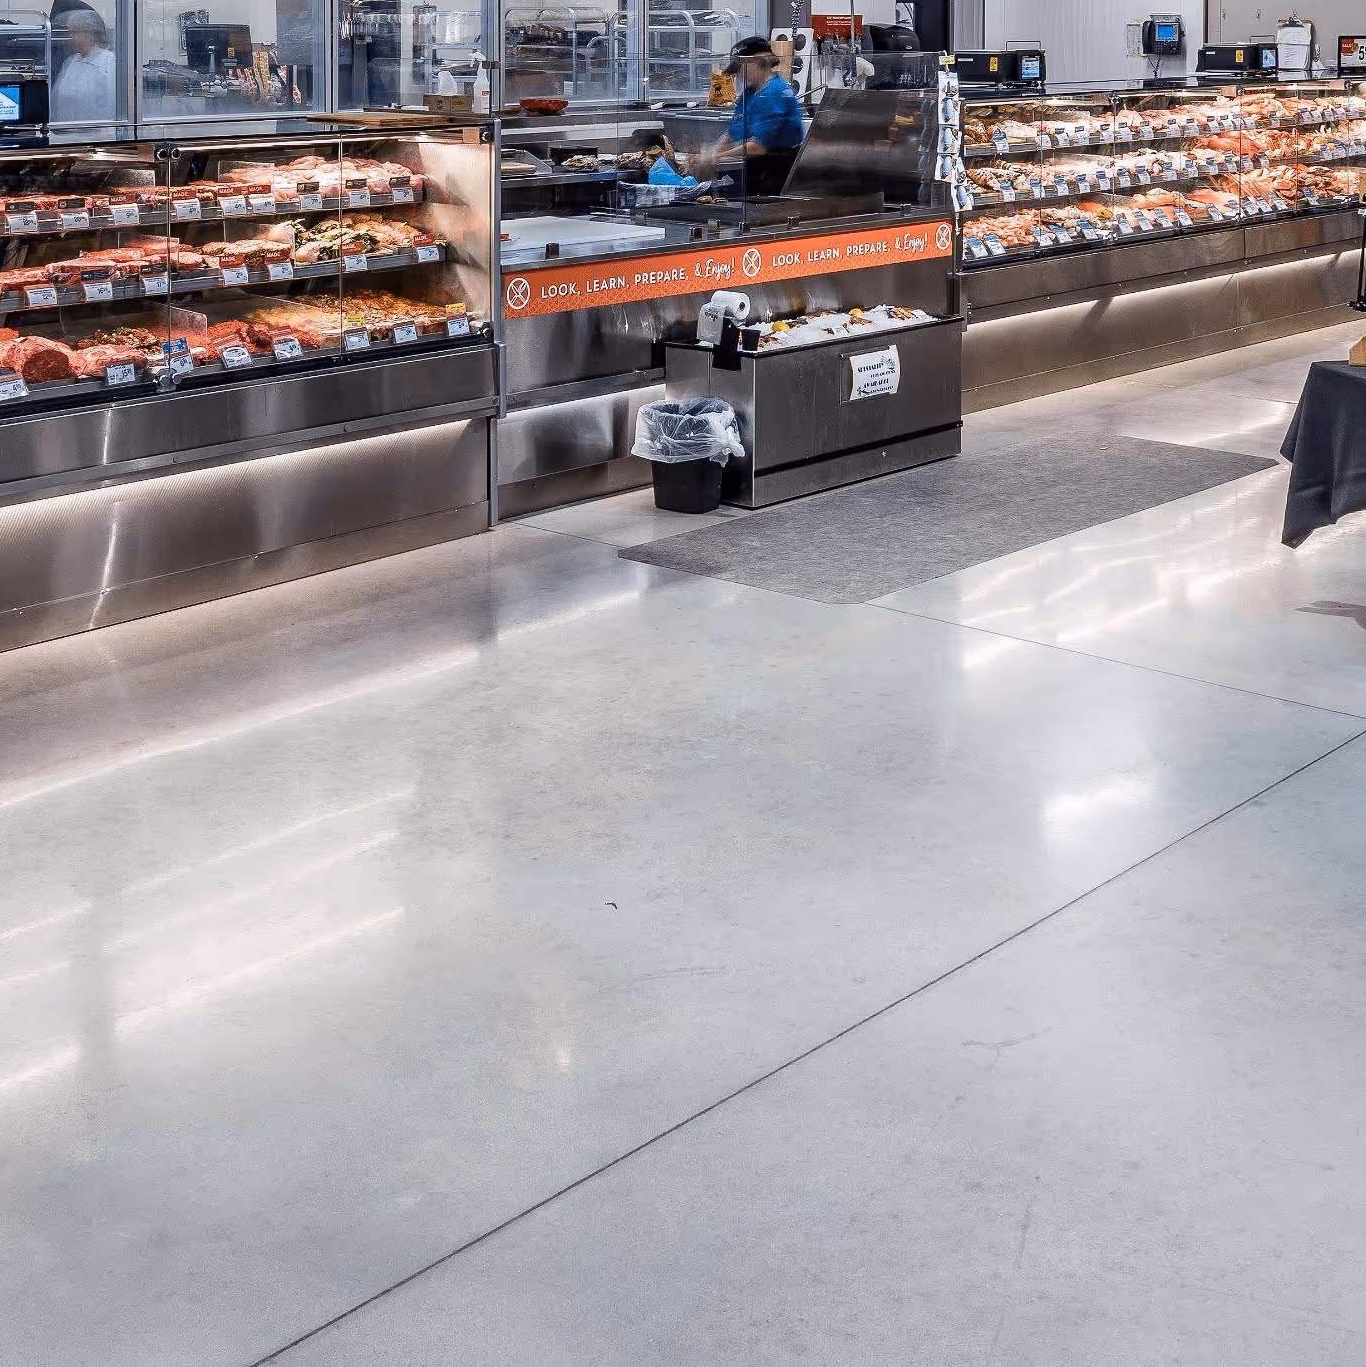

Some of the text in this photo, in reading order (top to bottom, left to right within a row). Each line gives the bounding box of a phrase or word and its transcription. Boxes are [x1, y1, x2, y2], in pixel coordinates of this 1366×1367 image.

[771, 232, 929, 267] LOOK, LEARN, PREPARE, & Enjoy!
[540, 256, 736, 300] LOOK, LEARN, PREPARE, & Enjoy!
